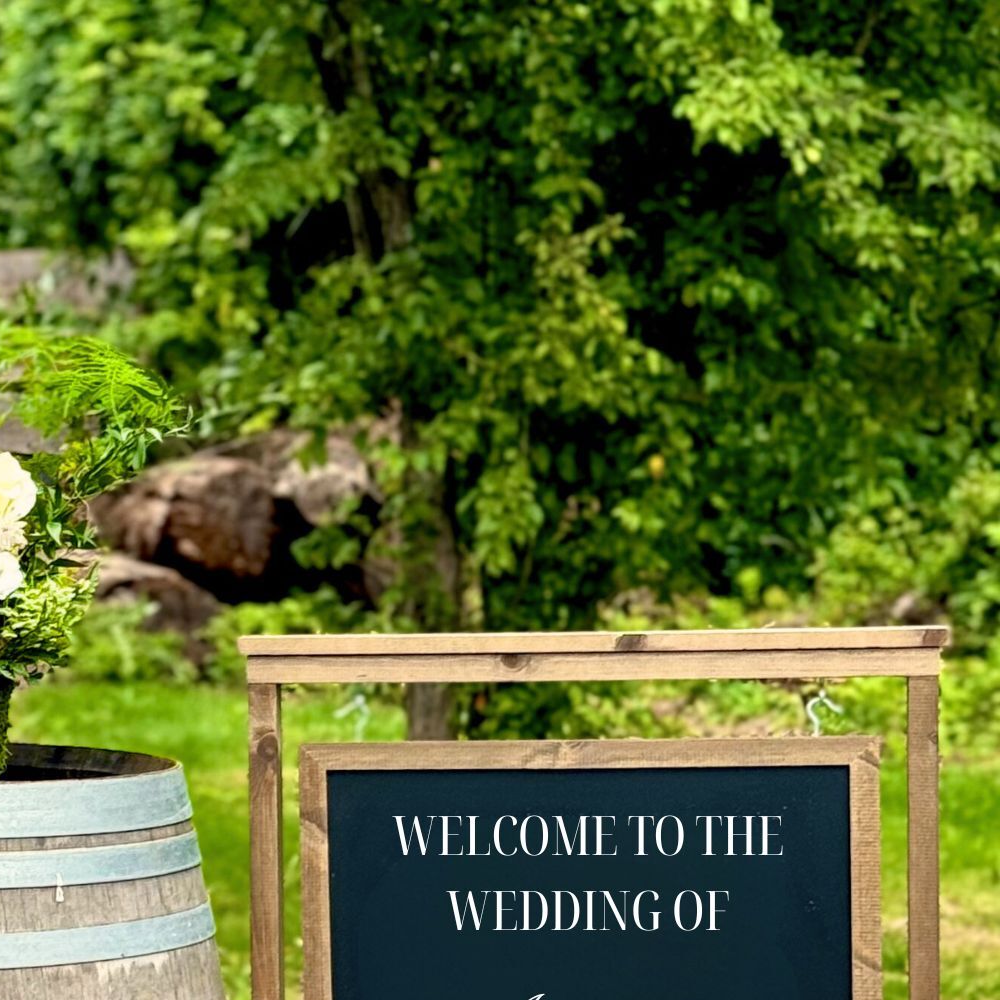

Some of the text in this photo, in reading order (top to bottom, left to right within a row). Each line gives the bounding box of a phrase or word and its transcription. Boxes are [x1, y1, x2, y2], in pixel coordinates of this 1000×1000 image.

[392, 815, 784, 857] WELCOME TO THE
[446, 890, 731, 932] WEDDING OF
